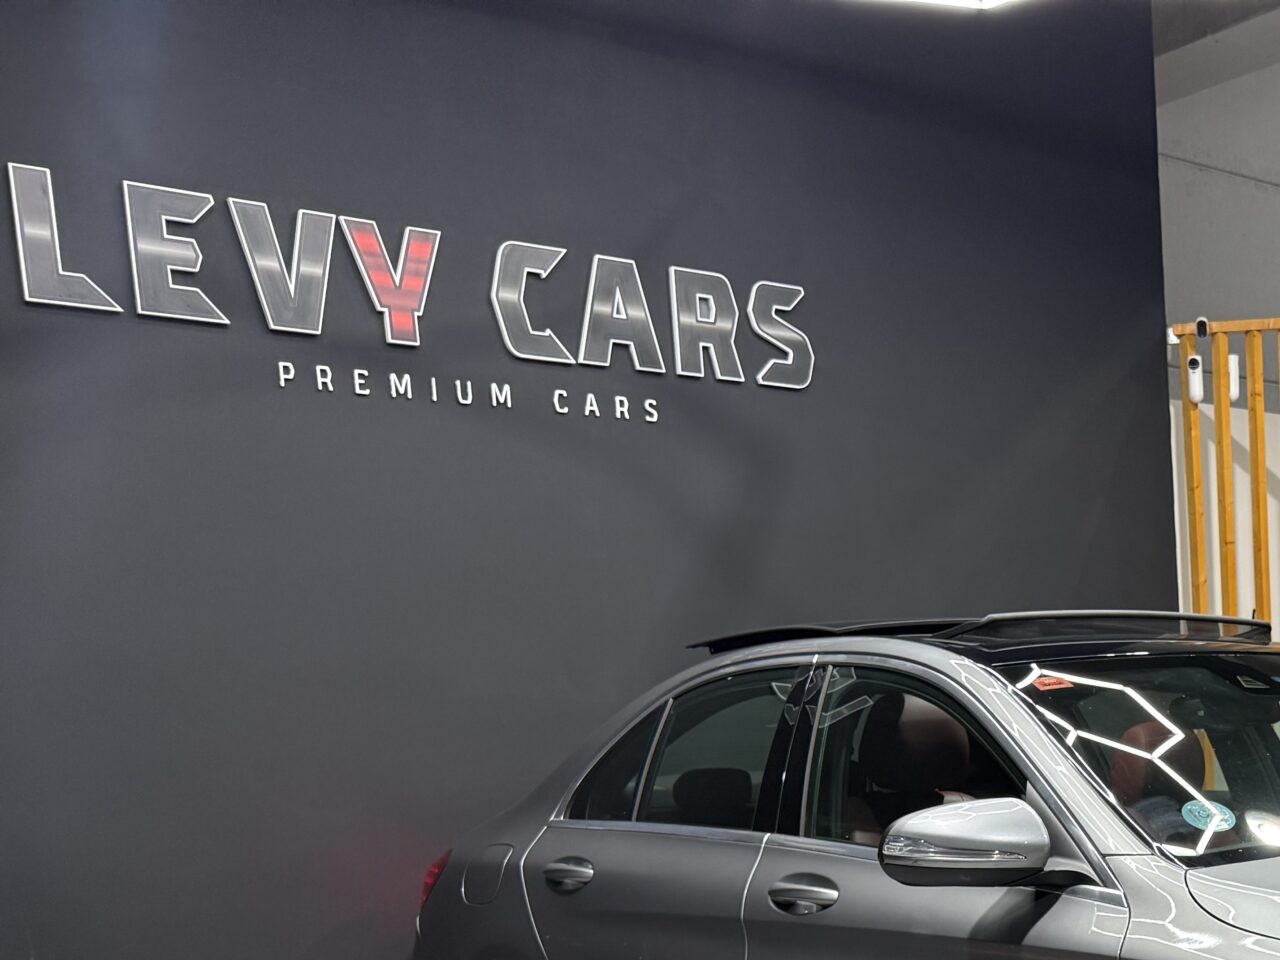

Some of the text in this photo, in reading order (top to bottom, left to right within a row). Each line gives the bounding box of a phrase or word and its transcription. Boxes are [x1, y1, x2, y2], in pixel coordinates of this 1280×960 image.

[7, 162, 816, 390] LEVY CARS
[278, 361, 659, 423] PREMIUM CARS
